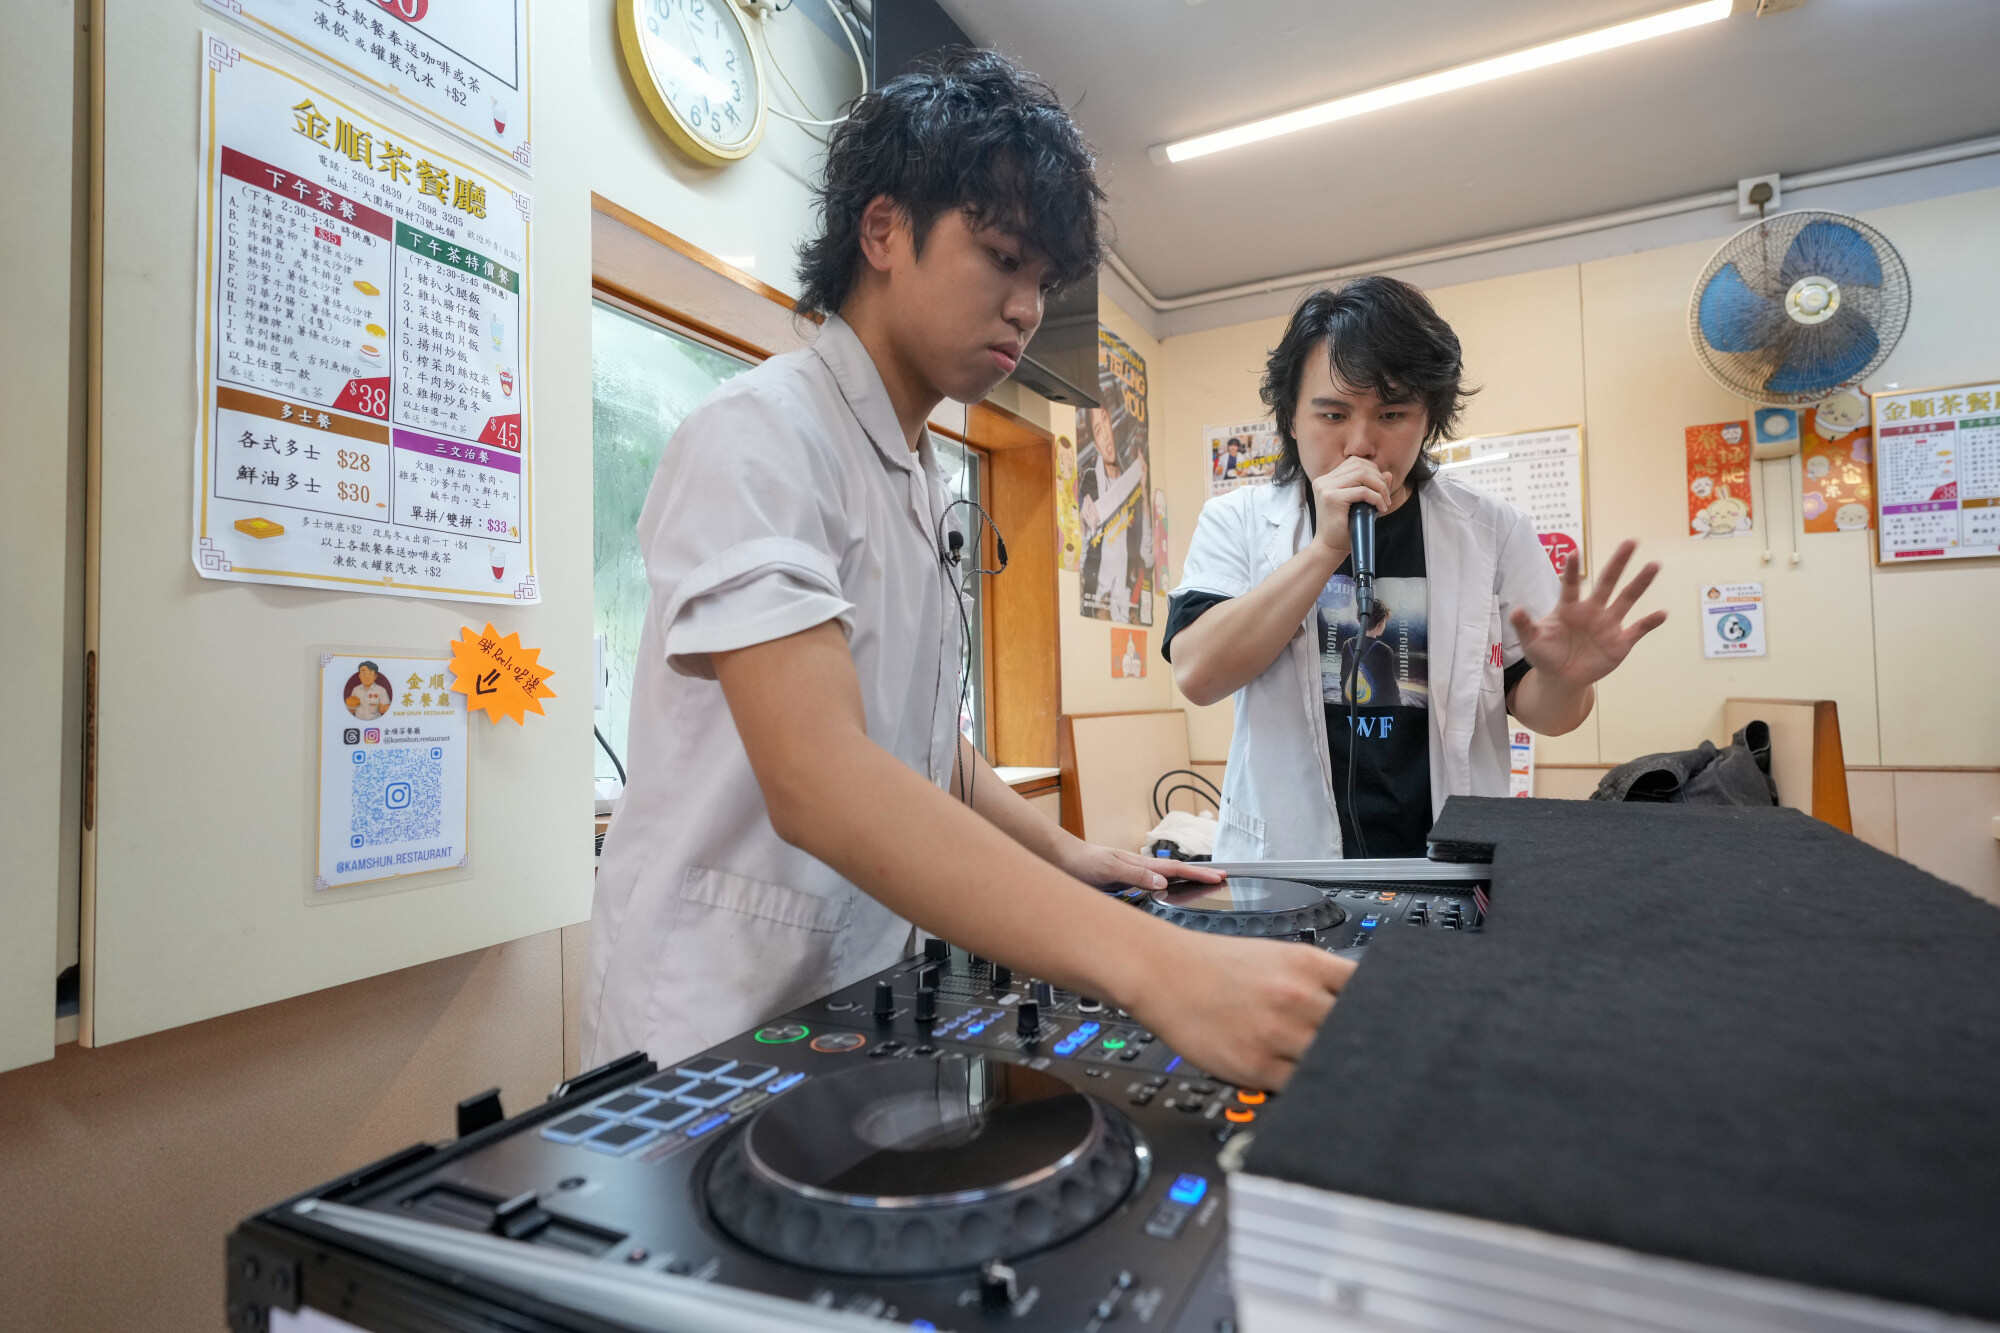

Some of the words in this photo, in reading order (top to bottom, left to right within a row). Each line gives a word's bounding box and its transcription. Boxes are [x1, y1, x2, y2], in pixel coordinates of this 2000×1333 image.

[725, 50, 736, 73] 2
[444, 84, 467, 107] +$2
[731, 80, 741, 102] 3
[691, 105, 701, 127] 6
[711, 112, 721, 134] 5
[724, 101, 742, 124] 4
[290, 90, 487, 224] 金順茶餐廳
[229, 195, 239, 208] A.
[265, 165, 357, 222] 下午茶餐
[352, 169, 374, 189] 2603
[442, 209, 463, 229] 3205
[228, 208, 239, 221] B.
[281, 199, 335, 231] 2:30-5:45
[228, 222, 238, 235] C.
[228, 235, 238, 249] D.
[227, 249, 238, 262] E.
[408, 227, 509, 286] 下午茶特價餐
[227, 263, 237, 276] F.
[436, 263, 478, 288] 2:30-5:45
[227, 276, 237, 289] G.
[403, 282, 413, 297] 2.
[404, 266, 412, 280] 1.
[417, 271, 480, 306] 豬扒火腿飯
[227, 290, 237, 303] H.
[403, 299, 412, 314] 3.
[226, 304, 237, 317] I.
[226, 318, 236, 330] J.
[402, 316, 413, 330] 4.
[226, 332, 236, 344] K.
[403, 332, 412, 346] 5.
[228, 349, 311, 381] 以上任選一款
[402, 349, 412, 363] 6.
[402, 365, 412, 380] 7.
[1110, 351, 1146, 396] TELLING
[350, 380, 385, 417] $38
[402, 381, 412, 395] 8.
[281, 402, 331, 429] 多士餐
[403, 399, 458, 421] 以上任選一款
[1121, 388, 1145, 423] YOU
[1884, 391, 2000, 421] 金順茶餐
[490, 416, 518, 450] $45
[238, 427, 320, 462] 各式多士
[337, 447, 370, 473] $28
[434, 441, 488, 463] 三文治餐
[236, 463, 320, 494] 鮮油多士
[336, 479, 370, 504] $30
[488, 518, 506, 533] $33
[423, 566, 441, 577] +$2
[406, 671, 446, 690] 金順
[401, 692, 451, 707] 茶餐廳
[336, 846, 453, 874] @KAMSHUN.RESTAURANT
